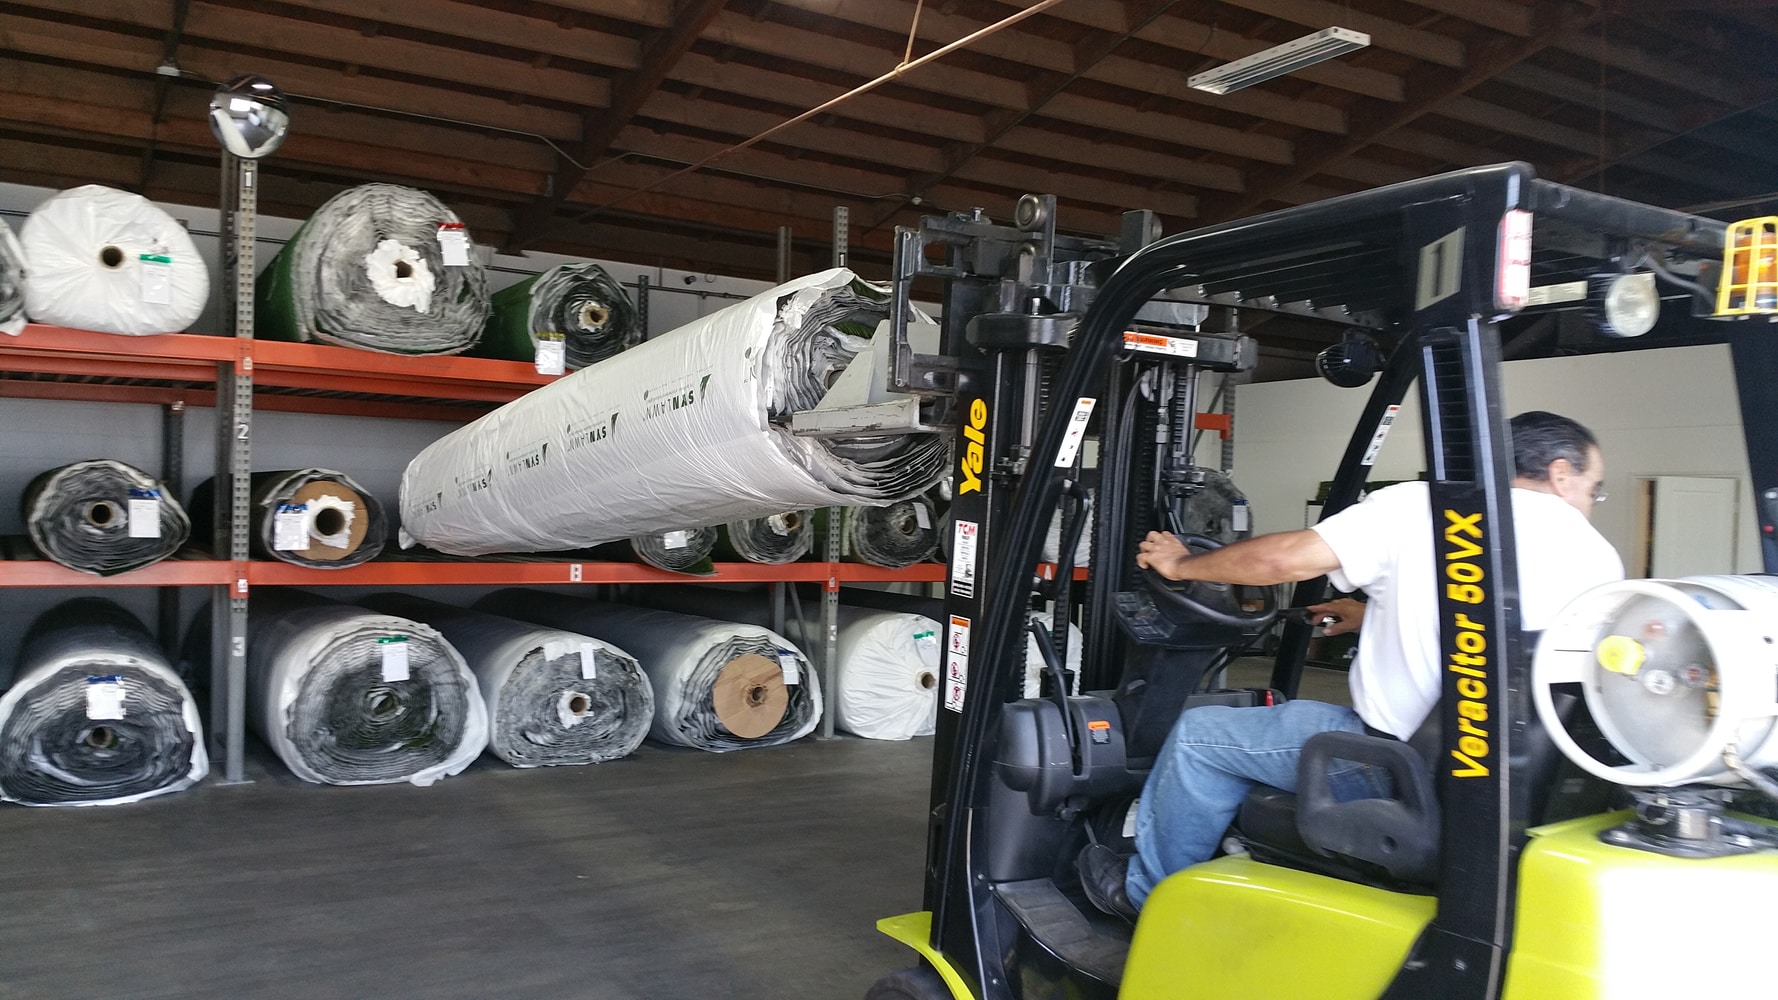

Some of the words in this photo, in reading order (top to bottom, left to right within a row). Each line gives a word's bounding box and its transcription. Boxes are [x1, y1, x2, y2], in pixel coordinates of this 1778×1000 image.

[245, 171, 252, 187] 1
[839, 253, 845, 267] 1
[646, 389, 694, 420] SYNLAWN
[237, 423, 249, 440] 2
[569, 425, 607, 451] SYNLAWN
[959, 398, 988, 494] Yale
[958, 523, 977, 537] TCM
[1443, 508, 1486, 605] 50VX
[570, 563, 583, 582] B
[1044, 565, 1053, 580] A
[231, 636, 246, 657] 3
